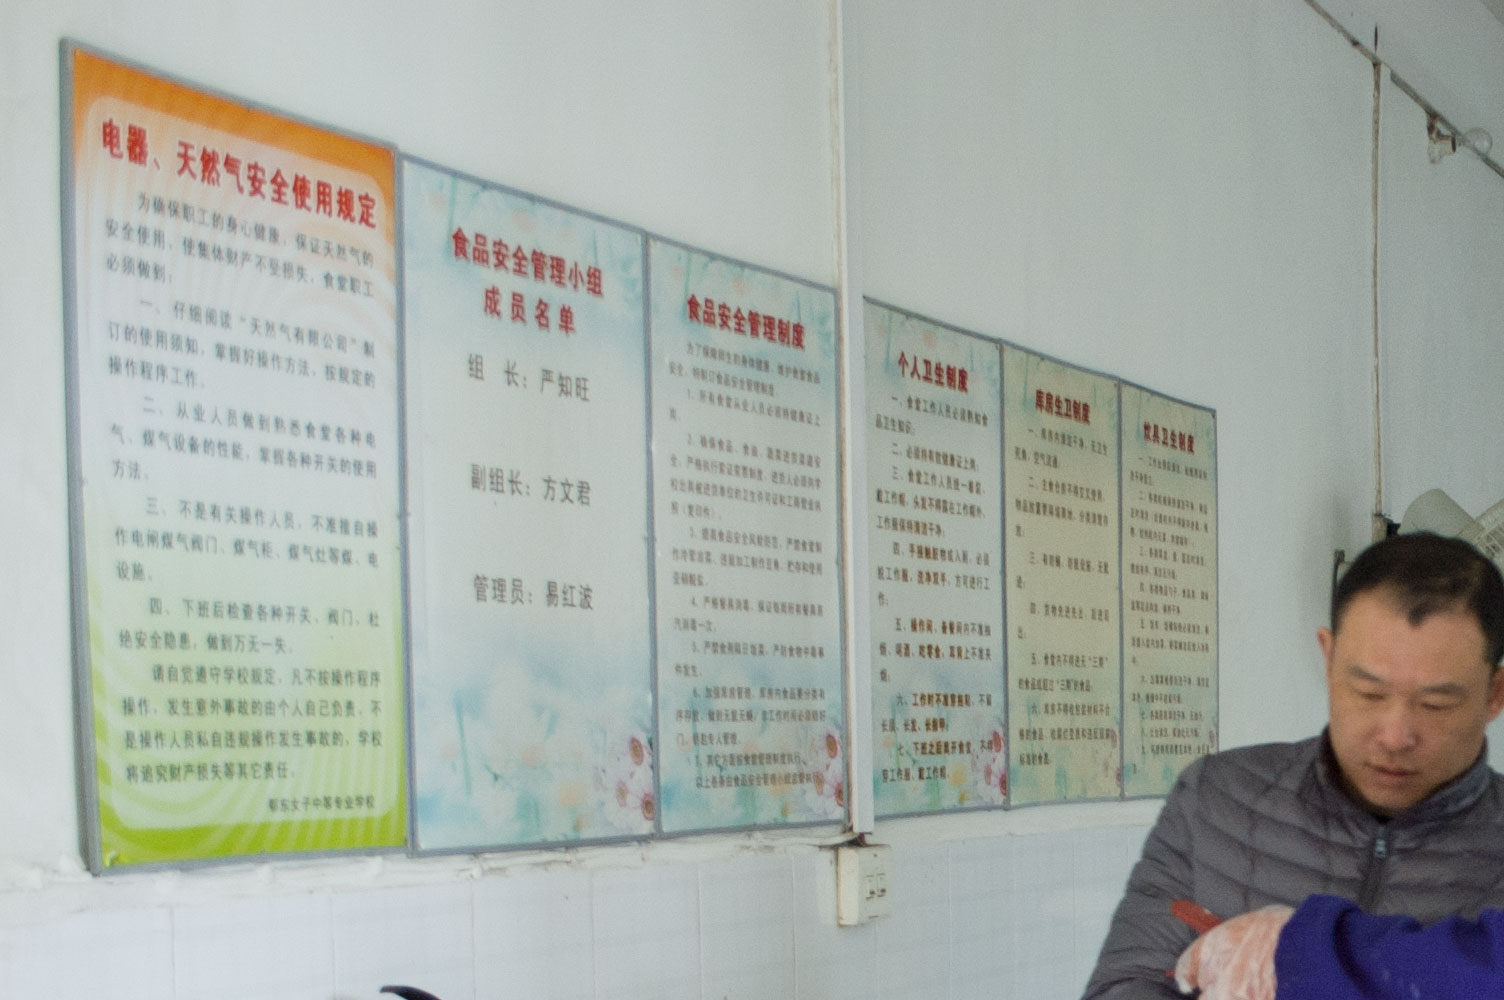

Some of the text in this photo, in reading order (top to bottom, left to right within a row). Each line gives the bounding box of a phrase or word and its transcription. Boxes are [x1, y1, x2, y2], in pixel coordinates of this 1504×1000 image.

[102, 118, 377, 230] 电器、天然气安全使用规定
[138, 191, 373, 268] 为确保职工的身心健康，保证天然气的
[451, 225, 603, 299] 食品安全管理小组
[483, 283, 575, 336] 成员名单
[686, 292, 805, 350] 食品安全管理制度
[108, 354, 204, 389] 操作程序工作。
[897, 350, 968, 393] 个人卫生制度
[142, 395, 375, 448] 二、从业人员做到熟悉食堂各种电
[111, 458, 148, 481] 方法。
[116, 561, 152, 583] 设施。
